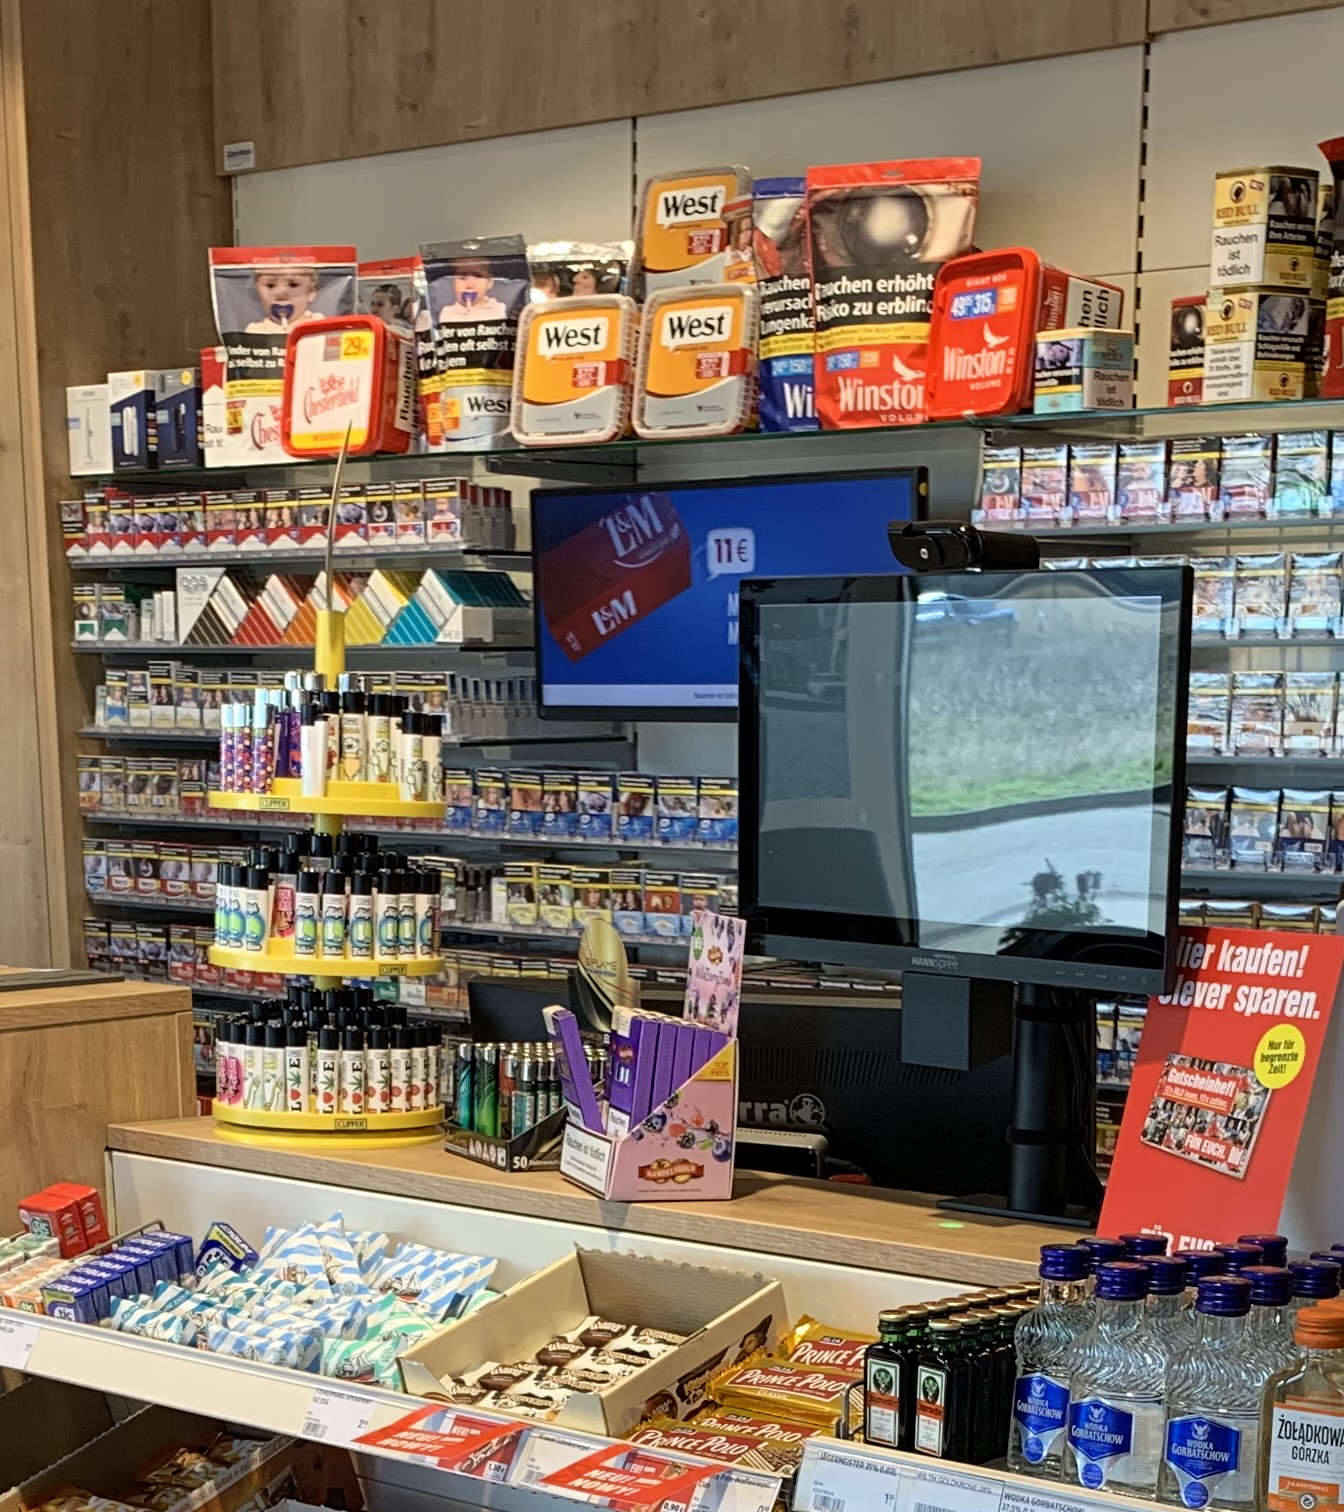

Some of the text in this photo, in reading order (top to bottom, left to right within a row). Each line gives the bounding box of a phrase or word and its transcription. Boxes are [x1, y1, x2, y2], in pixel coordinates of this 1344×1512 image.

[662, 192, 721, 217] West
[1215, 232, 1258, 249] Rauchen
[1217, 263, 1251, 277] tödlich
[668, 311, 727, 339] West
[545, 321, 601, 350] West
[944, 346, 1006, 381] Winston
[601, 495, 664, 557] L&M
[591, 590, 637, 635] L&M
[1217, 939, 1310, 978] kaufen!
[1236, 984, 1320, 1020] sparen.
[1268, 1039, 1294, 1051] Nur für
[1260, 1052, 1299, 1064] begrenzte
[1268, 1063, 1287, 1075] Zeit!
[1167, 1068, 1237, 1098] Gutscheinheft
[1185, 1135, 1226, 1160] FÜR EUCH.
[512, 1155, 528, 1170] 50
[646, 1161, 703, 1180] HANDELSGOLD
[398, 1430, 439, 1441] NEU!
[1070, 1426, 1124, 1448] GORBATSCHOW
[1186, 1439, 1213, 1451] WODKA
[381, 1441, 443, 1453] NOWY!
[1171, 1444, 1232, 1464] GORBATSCHOW
[1291, 1446, 1331, 1466] GORZKA
[590, 1469, 626, 1483] NEU!
[574, 1482, 641, 1496] NOWY!
